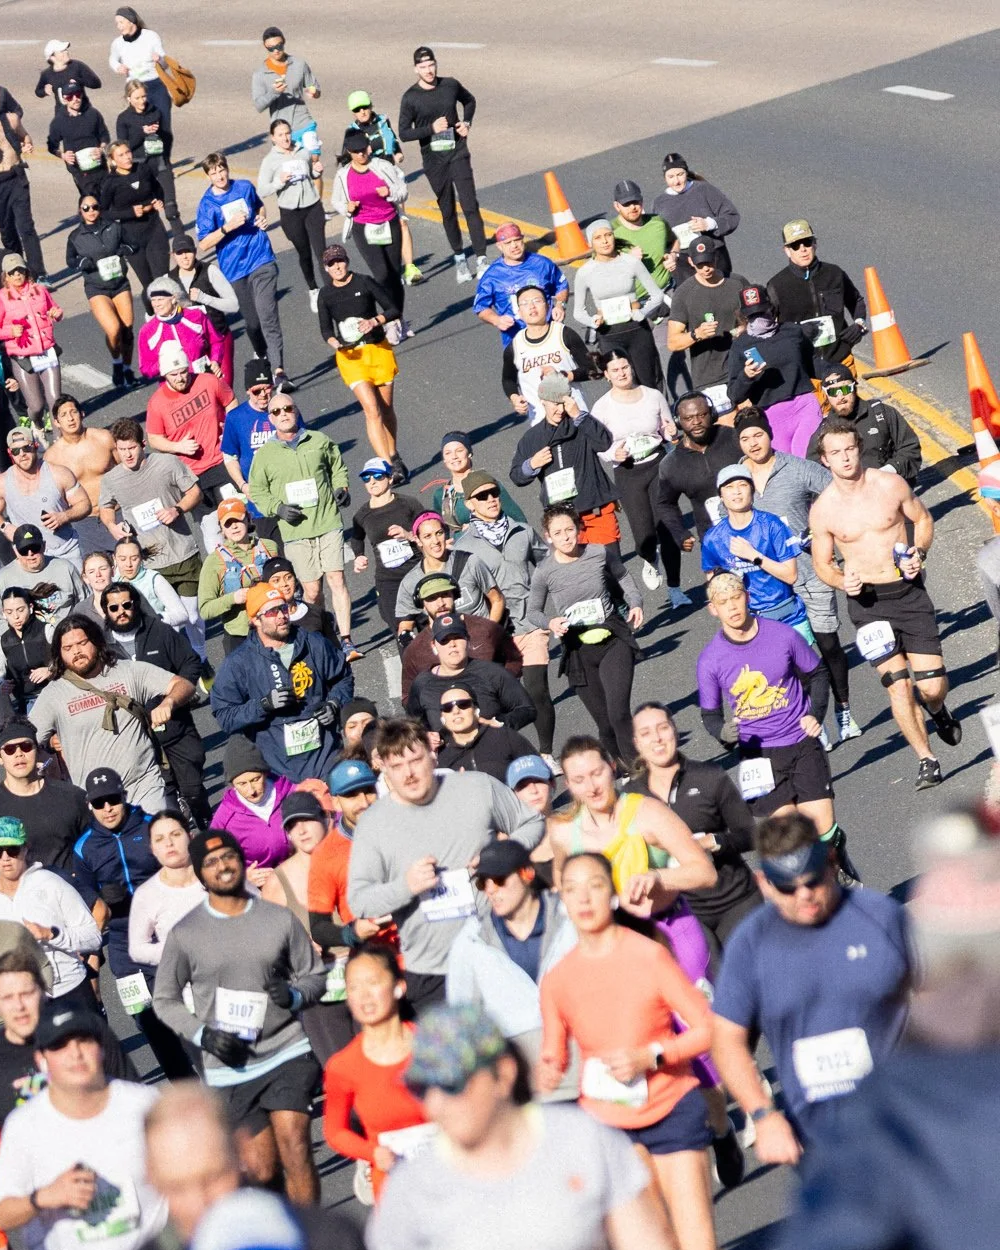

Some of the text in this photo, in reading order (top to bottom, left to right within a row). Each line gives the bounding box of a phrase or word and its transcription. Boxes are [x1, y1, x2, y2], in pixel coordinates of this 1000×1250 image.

[522, 351, 562, 373] LAKERS
[172, 391, 211, 427] BOLD
[251, 430, 276, 445] GIAN
[270, 663, 283, 689] ODYS
[228, 1003, 254, 1018] 3107
